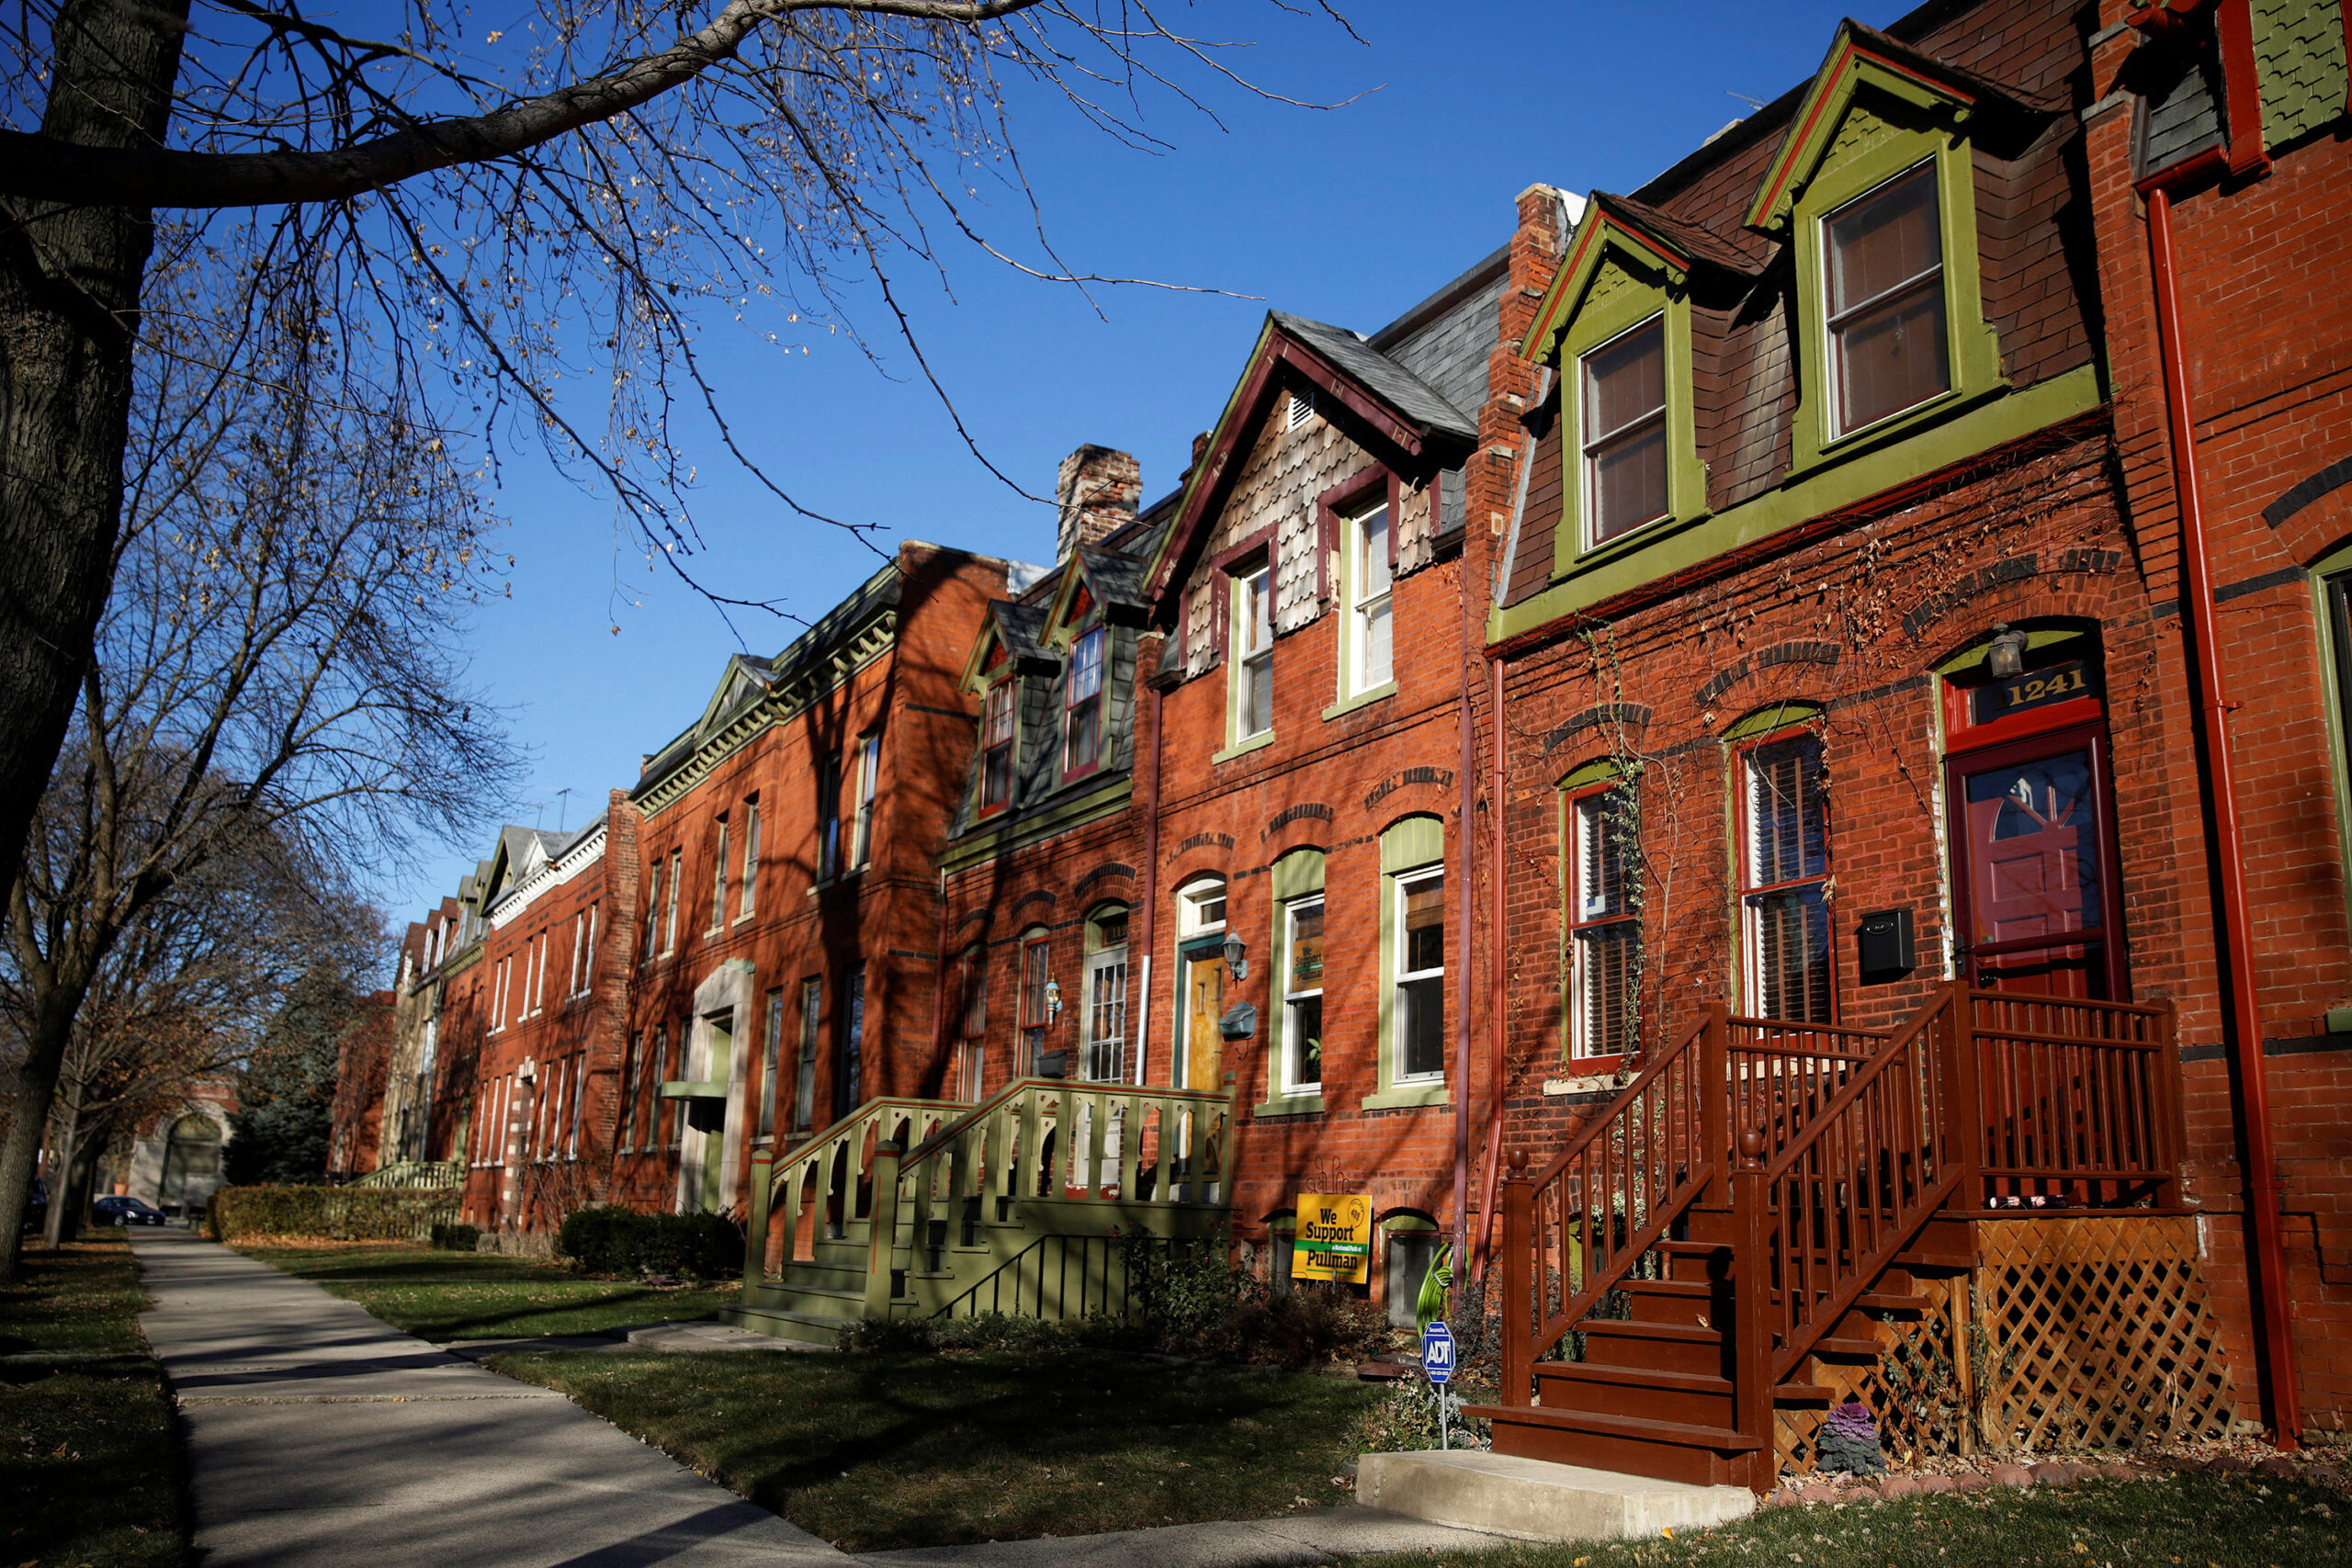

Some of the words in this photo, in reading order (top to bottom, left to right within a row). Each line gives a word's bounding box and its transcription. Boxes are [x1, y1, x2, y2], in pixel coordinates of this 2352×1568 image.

[1295, 953, 1322, 967] Support
[1303, 946, 1312, 956] We
[1320, 1208, 1337, 1224] We
[1306, 1222, 1354, 1245] Support
[1306, 1249, 1358, 1270] Pullman
[1427, 1341, 1451, 1364] ADT
